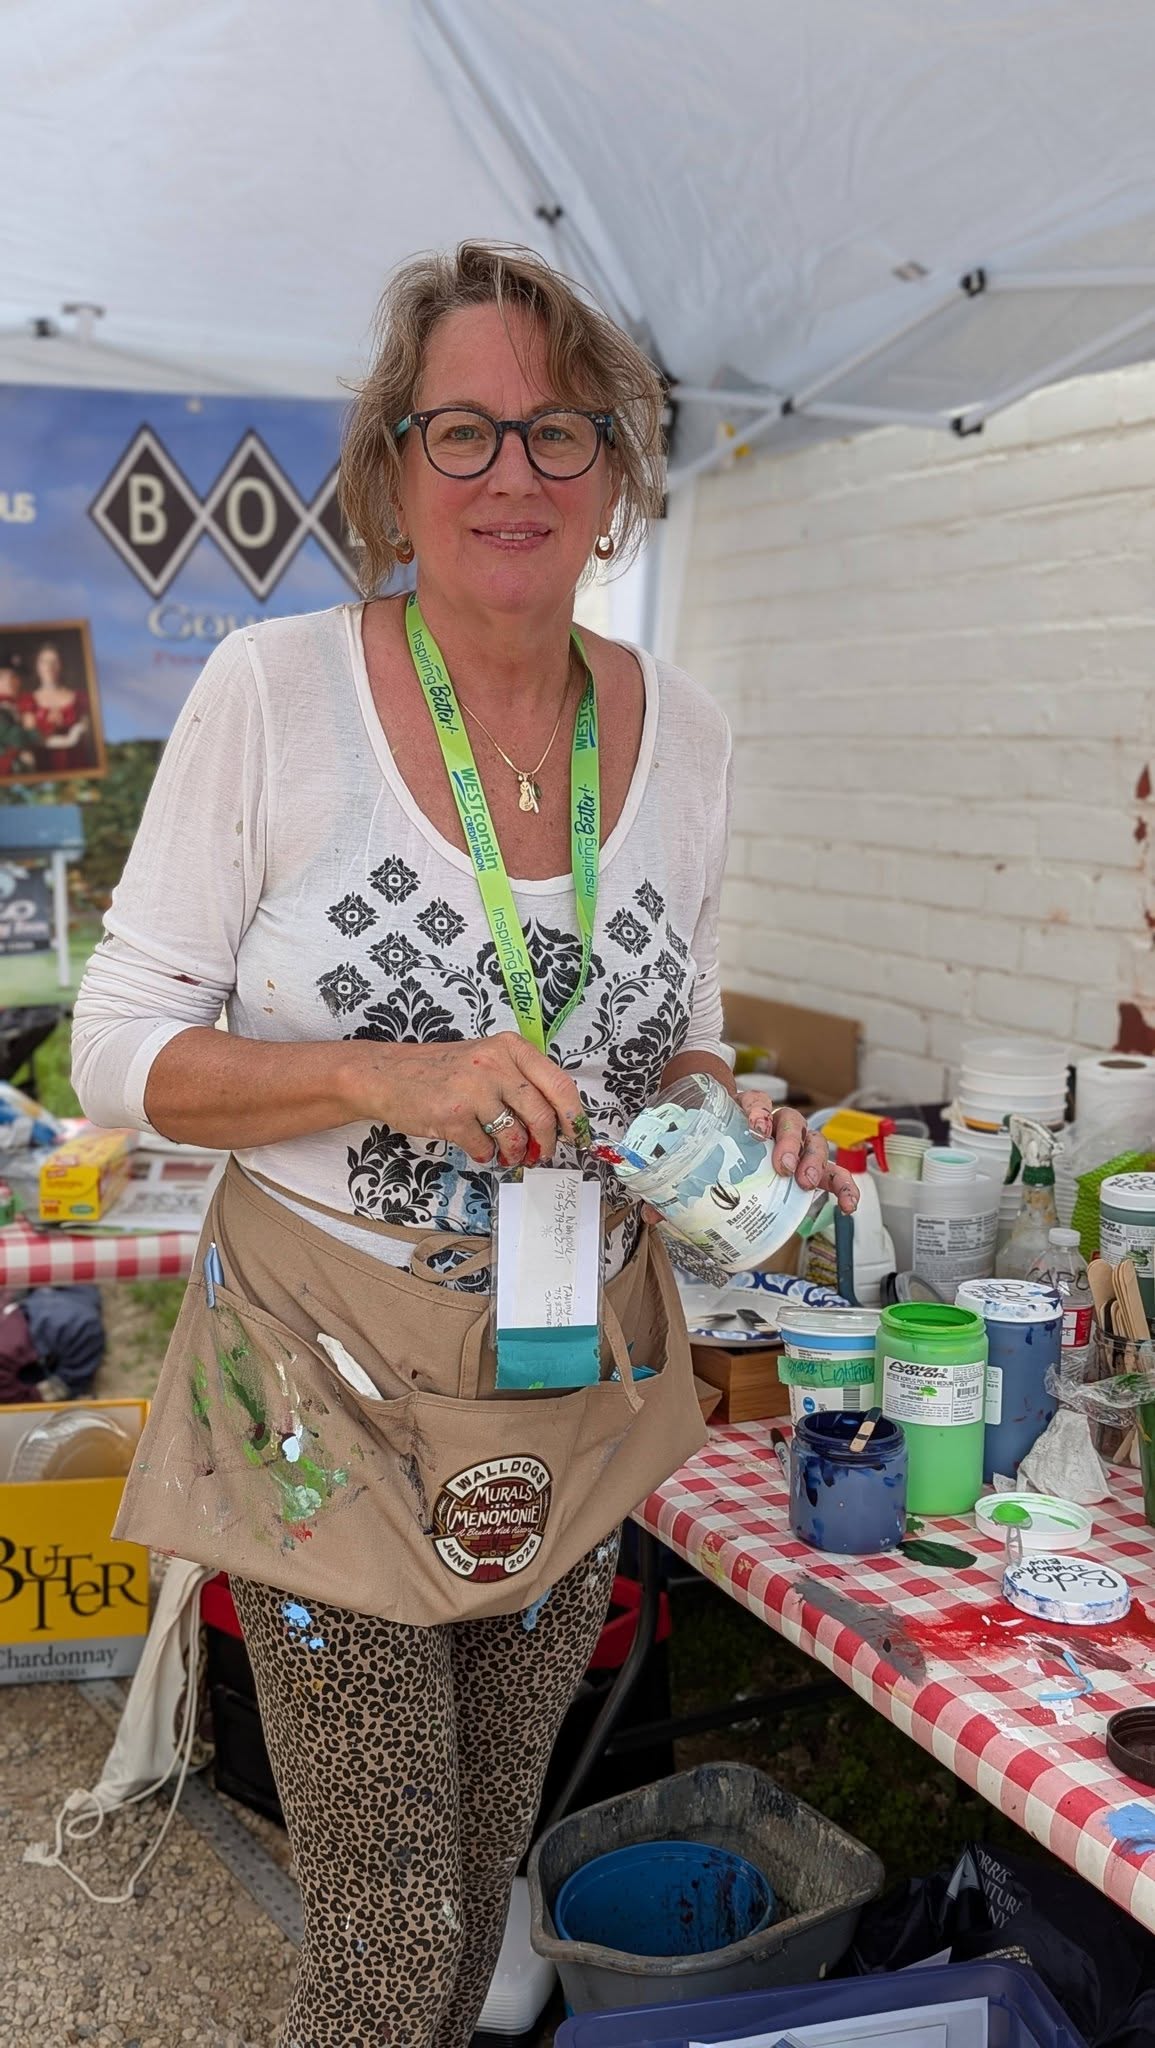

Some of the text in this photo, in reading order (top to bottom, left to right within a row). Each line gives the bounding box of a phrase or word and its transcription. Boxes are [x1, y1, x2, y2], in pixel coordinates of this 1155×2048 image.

[411, 628, 460, 735] Inspiring Better!
[460, 767, 498, 871] WESTconsin
[464, 815, 486, 872] CREDIT UNION
[574, 783, 597, 898] Inspiring Better!
[492, 907, 536, 1025] Inspiring Better!
[747, 1194, 759, 1206] 15
[889, 1365, 949, 1379] COLOR
[892, 1361, 940, 1373] NOVA
[455, 1460, 546, 1492] WALLDOGS
[471, 1484, 534, 1506] MURALS
[449, 1505, 540, 1530] MENOMONIE
[442, 1541, 474, 1573] JUNE
[975, 1846, 1012, 1884] ORRIS
